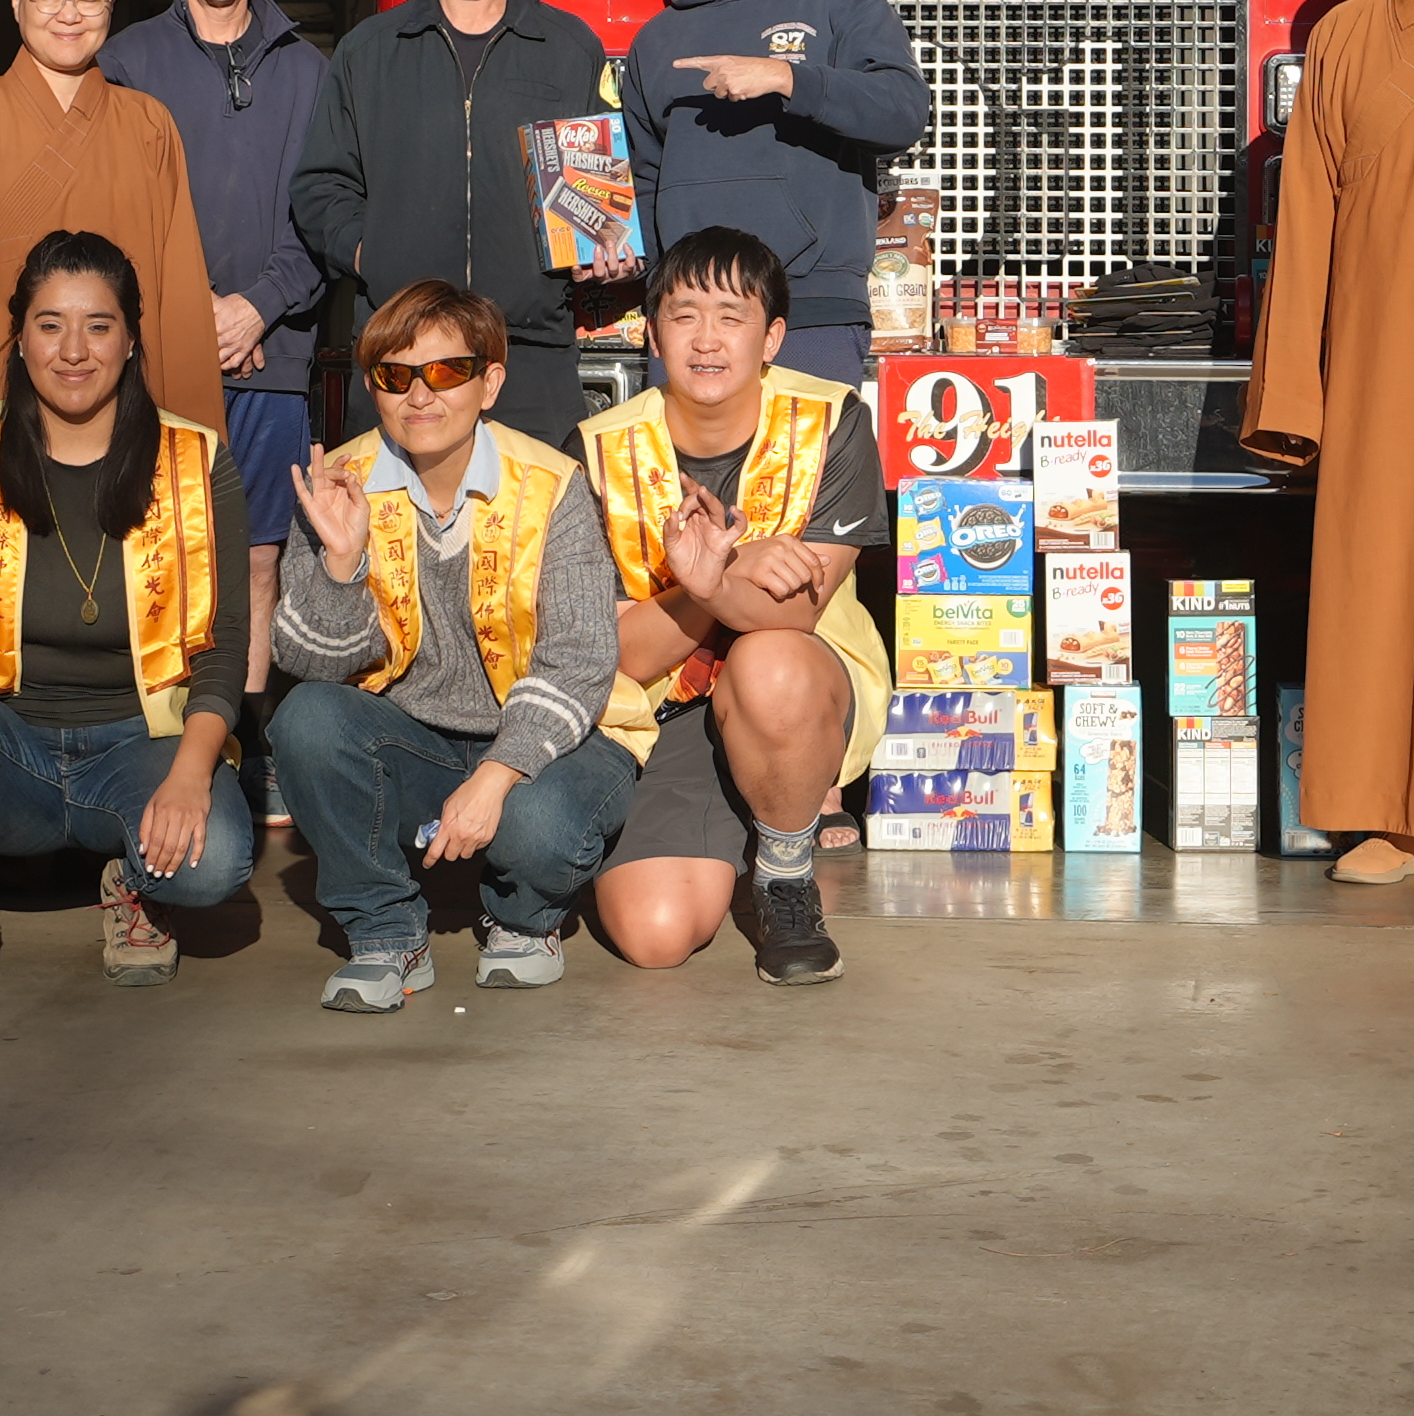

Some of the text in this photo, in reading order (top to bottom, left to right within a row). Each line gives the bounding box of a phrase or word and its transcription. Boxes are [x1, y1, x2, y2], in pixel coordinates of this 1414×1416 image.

[1255, 239, 1272, 252] KI
[897, 409, 1061, 449] The Heig
[905, 371, 1044, 474] 91
[1040, 430, 1112, 448] nutella
[951, 524, 1022, 546] OREO
[1052, 562, 1124, 580] nutella
[474, 550, 506, 670] 國際佛光會
[933, 600, 994, 619] belVita
[1172, 596, 1216, 610] KIND
[1079, 703, 1118, 715] SOFT &
[928, 710, 999, 725] Red Bull
[1075, 716, 1117, 728] CHEWY
[1177, 729, 1212, 740] KIND
[1073, 763, 1086, 774] 64
[924, 791, 994, 805] Red Bull
[1073, 804, 1087, 817] 100
